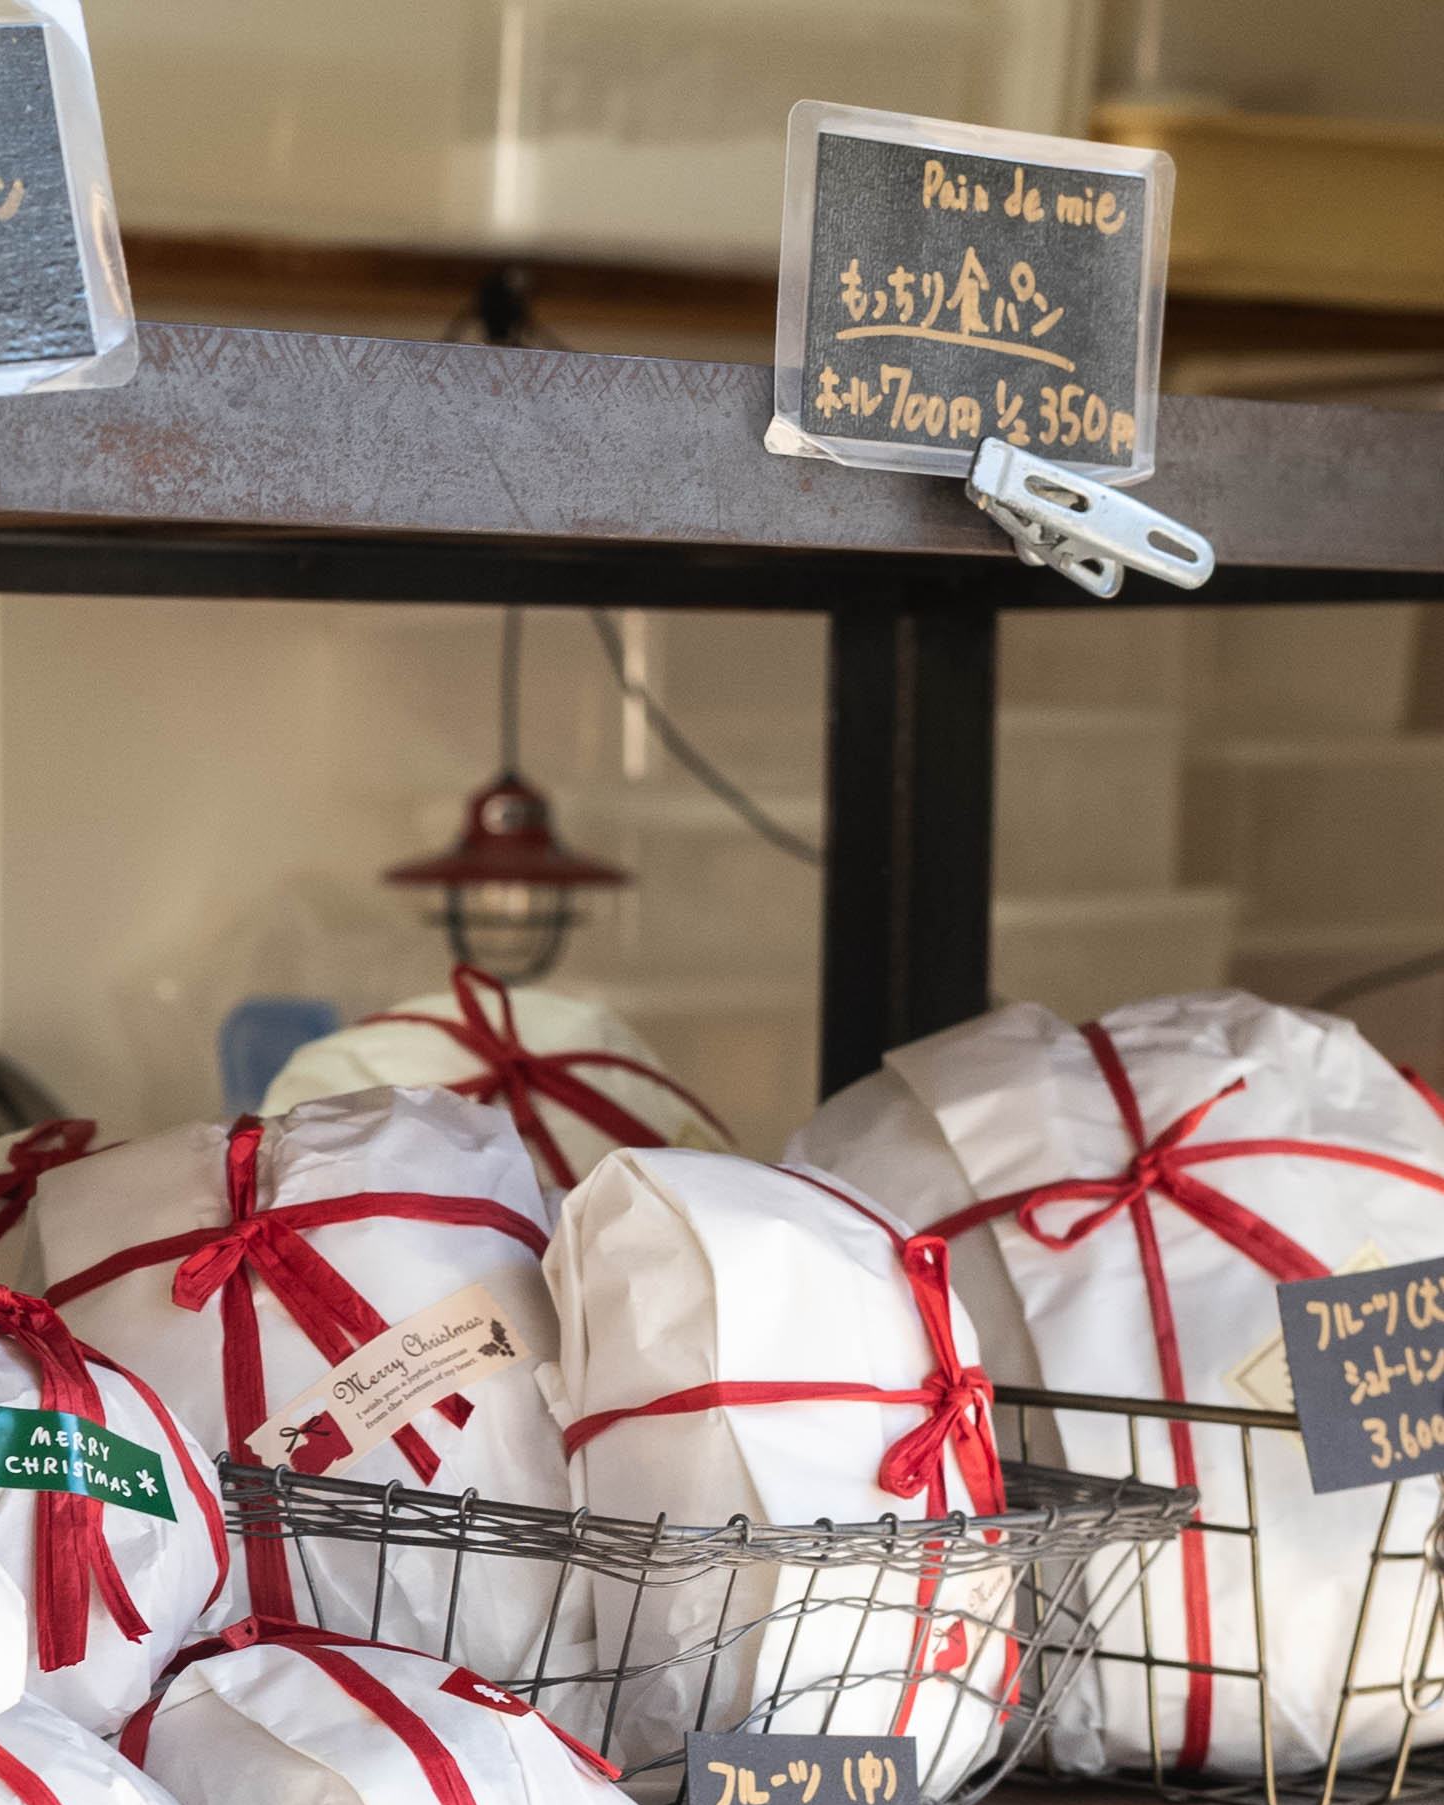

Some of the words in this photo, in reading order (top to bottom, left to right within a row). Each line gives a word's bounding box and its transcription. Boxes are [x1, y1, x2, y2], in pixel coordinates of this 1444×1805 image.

[923, 160, 989, 211] Pain
[1004, 168, 1045, 222] de
[1057, 188, 1126, 234] mie
[841, 247, 1064, 338] もっちり食パン
[1306, 1276, 1444, 1350] フルーツ(大
[332, 1358, 409, 1405] Merry
[401, 1316, 485, 1358] Christmas
[387, 1399, 404, 1412] the
[402, 1380, 435, 1401] bottom
[5, 1456, 132, 1497] CHRISTMAS
[30, 1426, 110, 1461] MERRY
